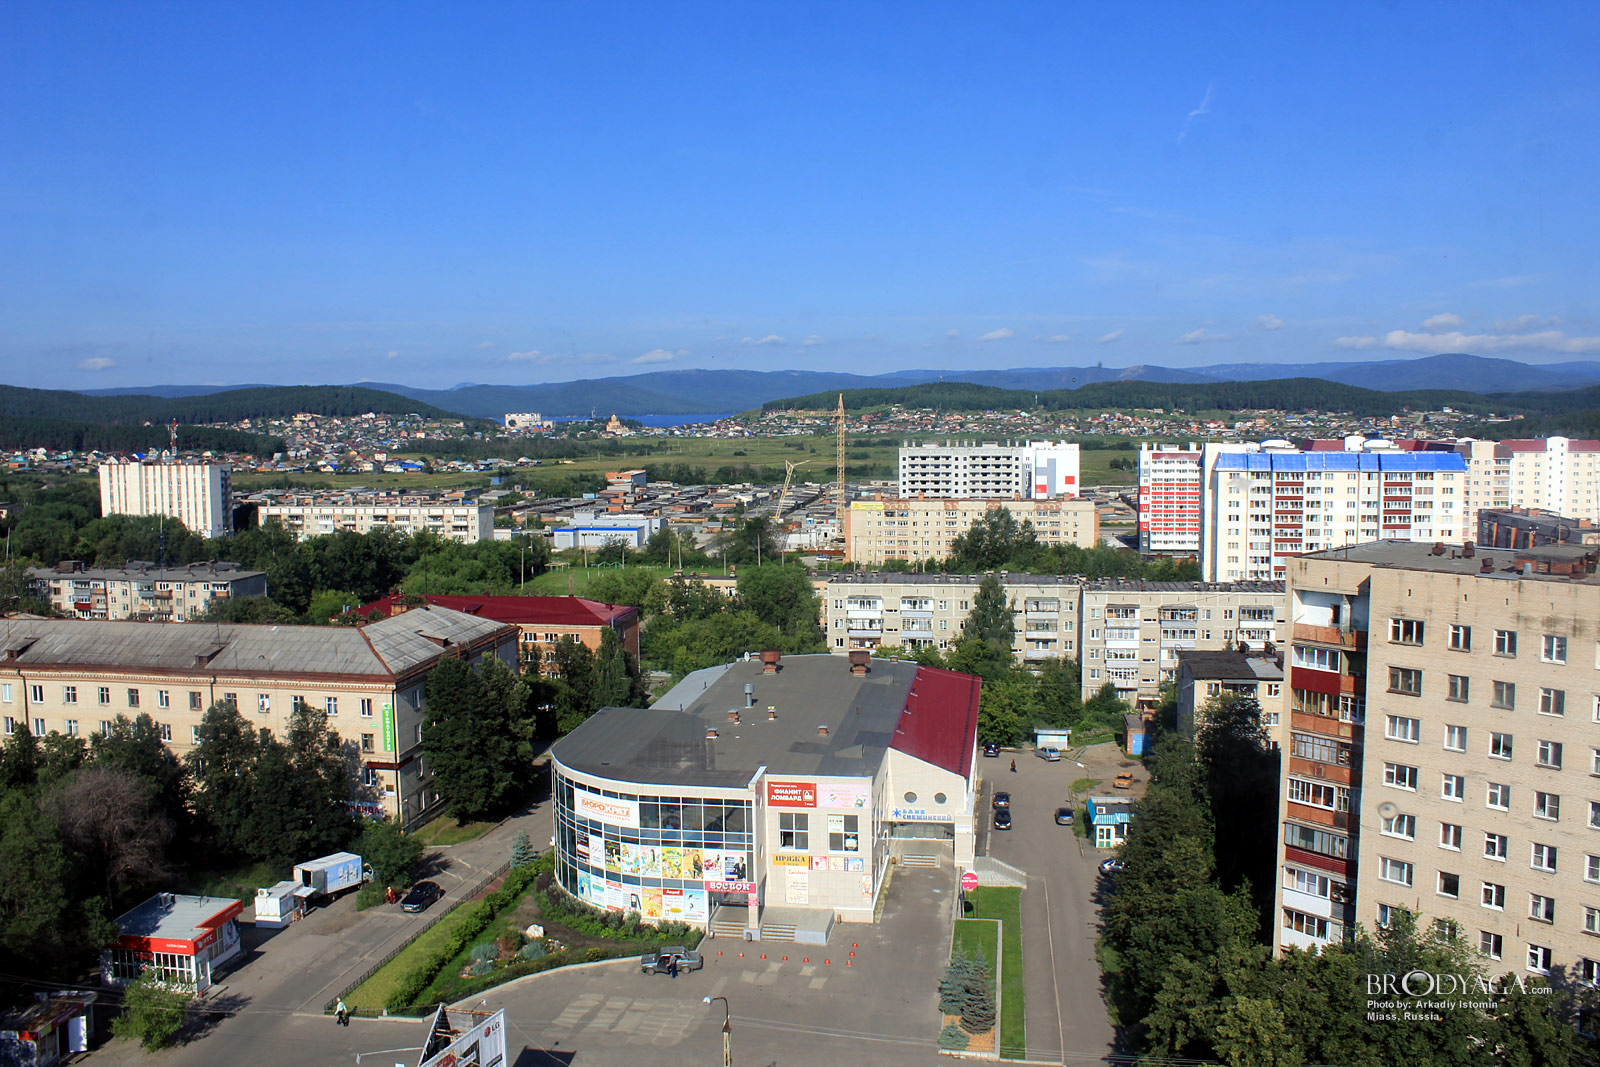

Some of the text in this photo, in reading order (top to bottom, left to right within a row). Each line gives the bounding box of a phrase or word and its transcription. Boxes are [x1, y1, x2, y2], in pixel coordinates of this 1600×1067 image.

[582, 798, 630, 817] БЮРОКРАТ
[710, 881, 750, 891] ВОСТОК
[491, 1022, 499, 1031] LG
